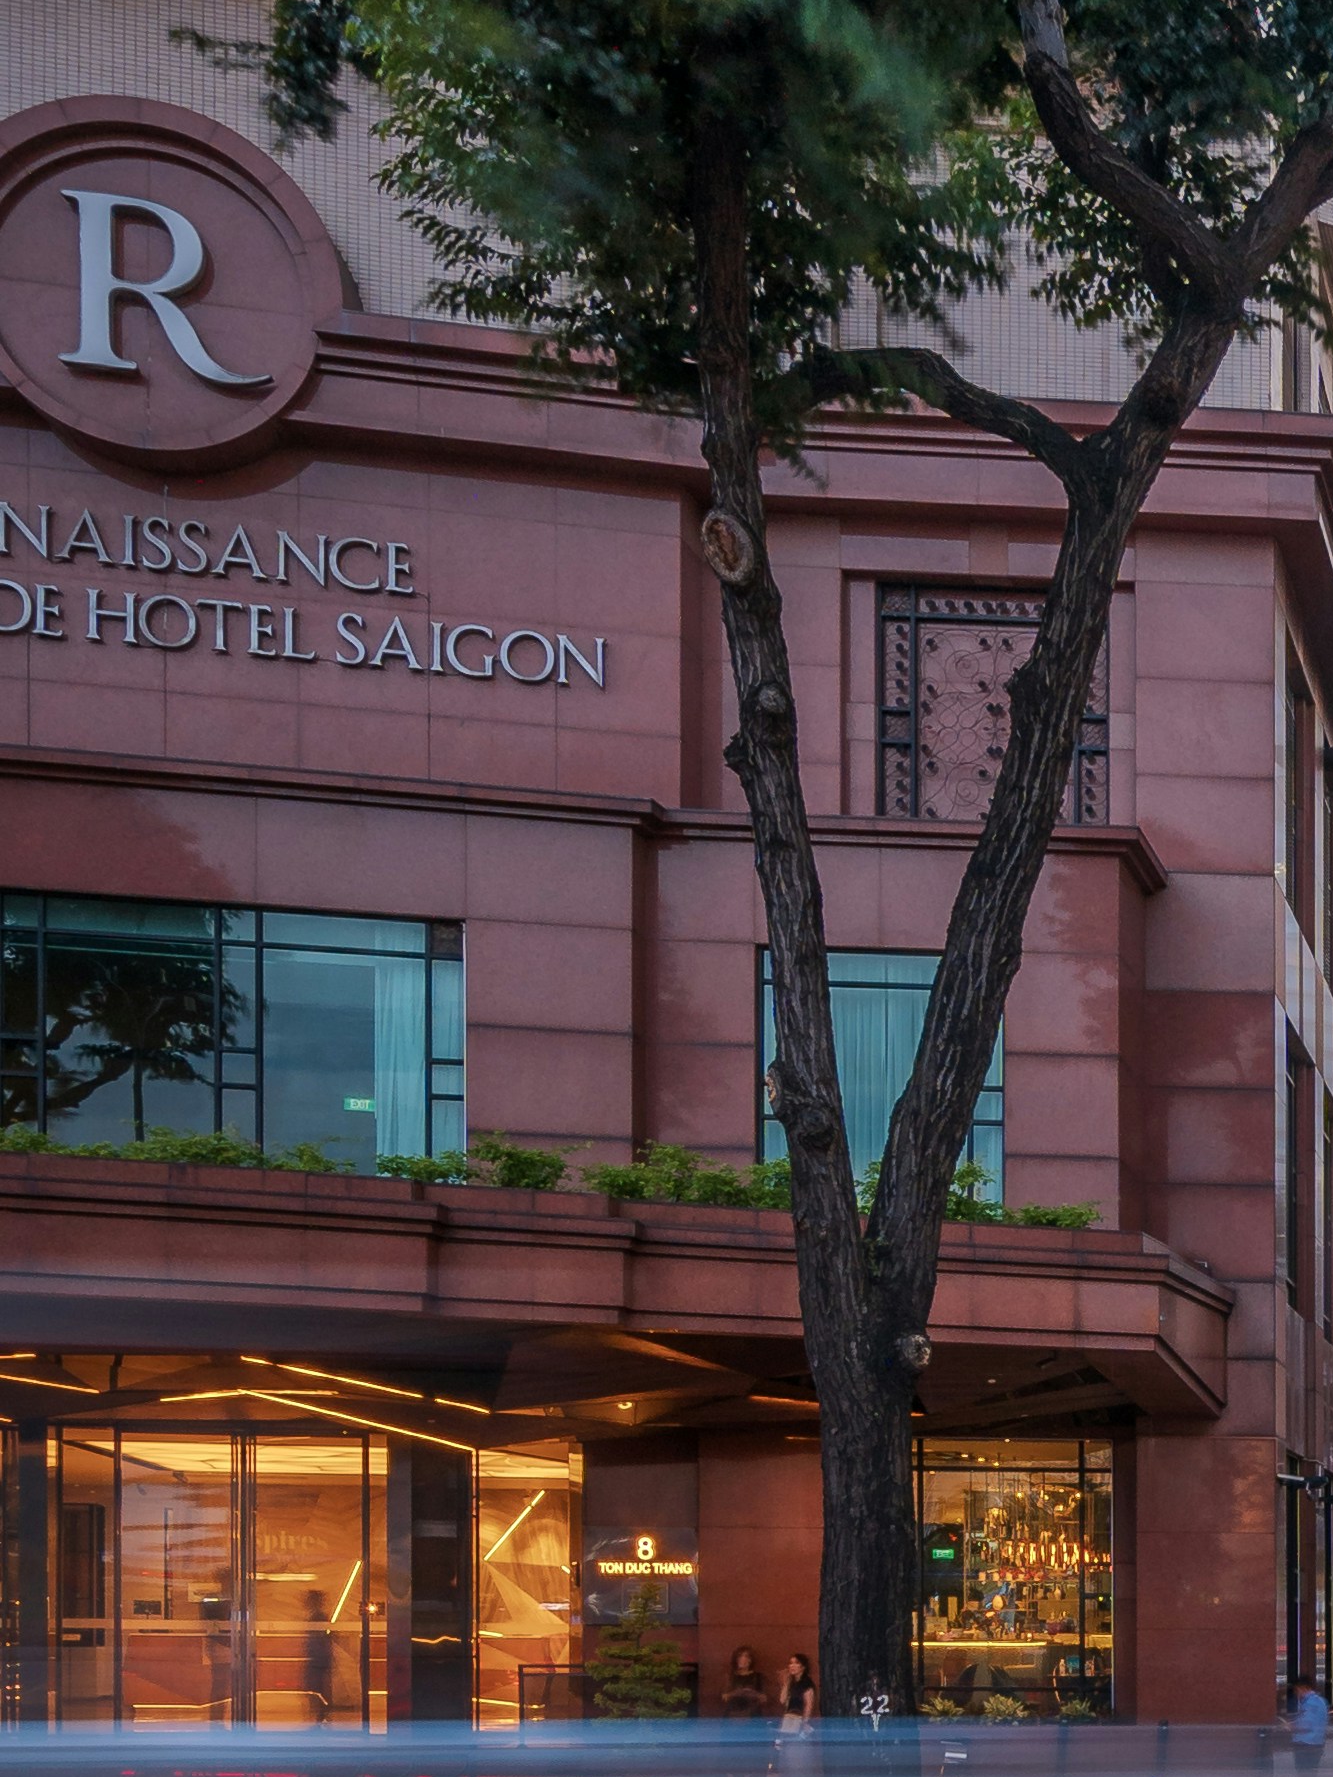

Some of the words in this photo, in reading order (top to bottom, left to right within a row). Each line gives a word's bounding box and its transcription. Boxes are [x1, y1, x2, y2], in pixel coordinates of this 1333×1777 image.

[58, 189, 274, 385] R
[0, 501, 414, 595] NAISSANCE
[85, 588, 316, 660] HOTEL
[335, 612, 607, 688] SAIGON
[598, 1563, 623, 1574] TON
[625, 1563, 651, 1574] DUC
[652, 1563, 693, 1574] THANG
[637, 1536, 654, 1560] 8
[860, 1695, 890, 1715] 22
